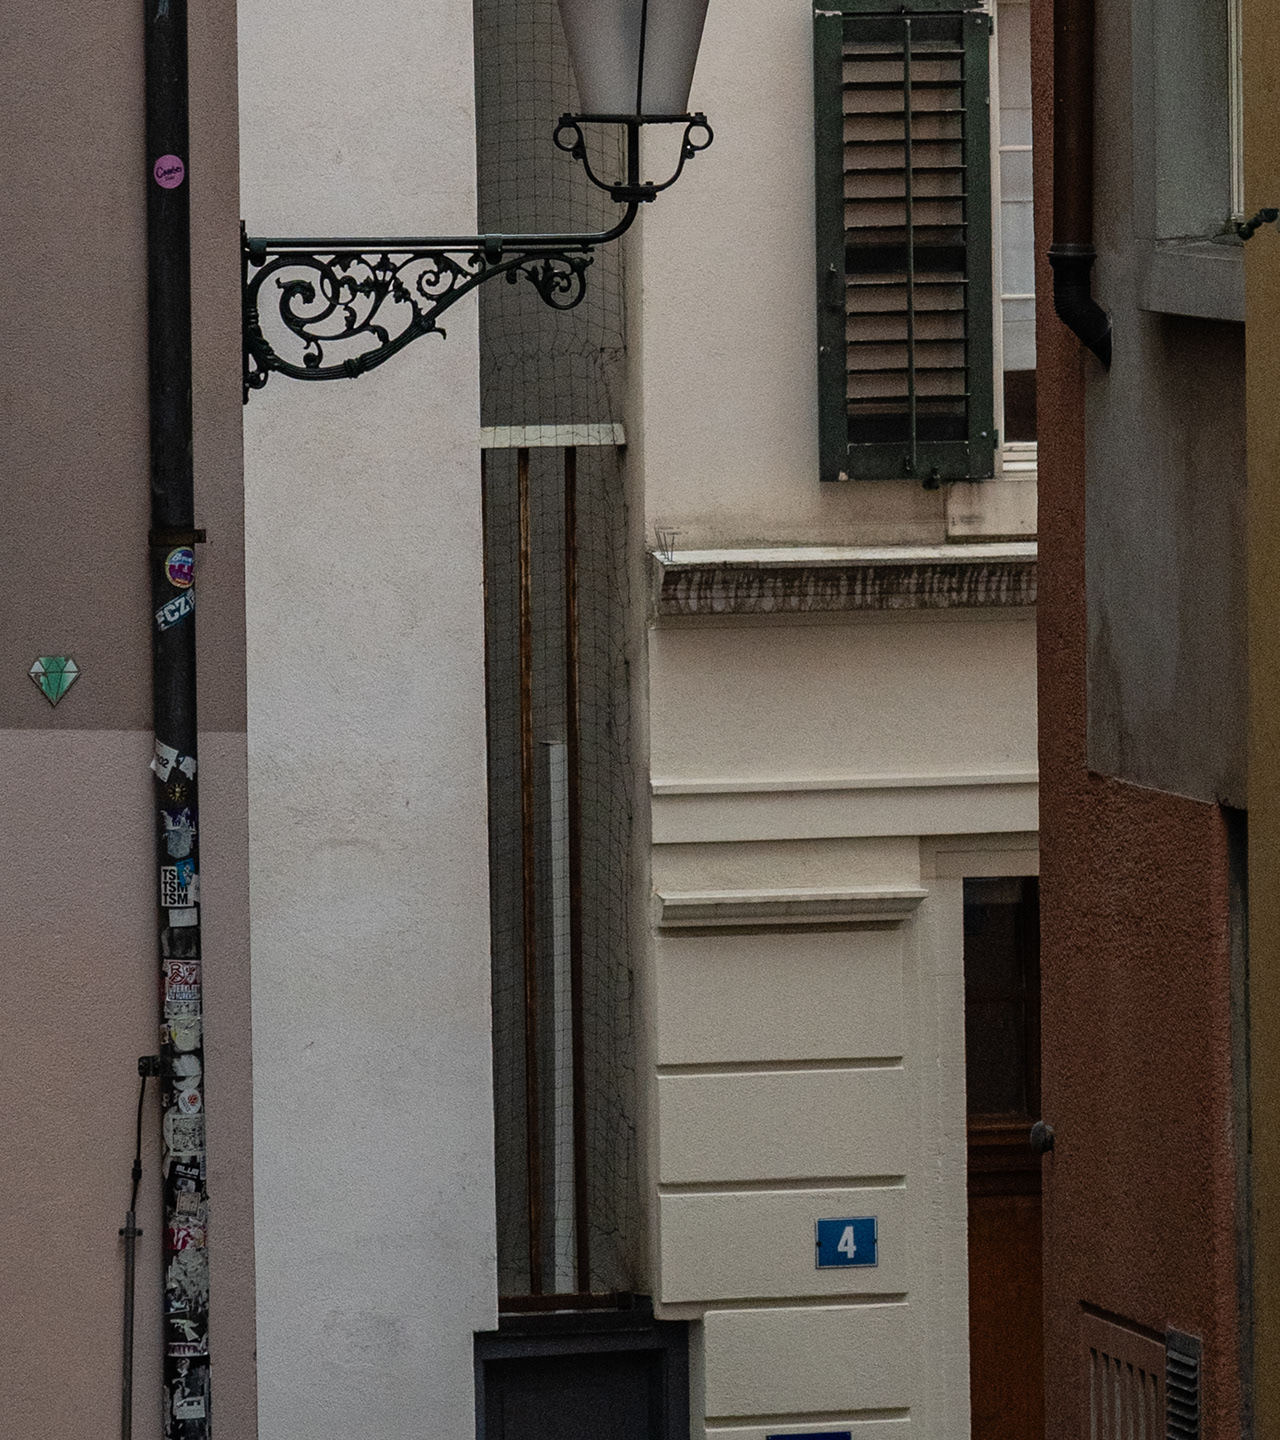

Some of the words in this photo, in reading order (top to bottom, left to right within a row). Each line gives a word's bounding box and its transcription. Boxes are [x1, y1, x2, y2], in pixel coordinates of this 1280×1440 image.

[163, 869, 179, 881] TS
[163, 881, 188, 893] TSM
[163, 893, 188, 905] TSM
[837, 1225, 857, 1259] 4
